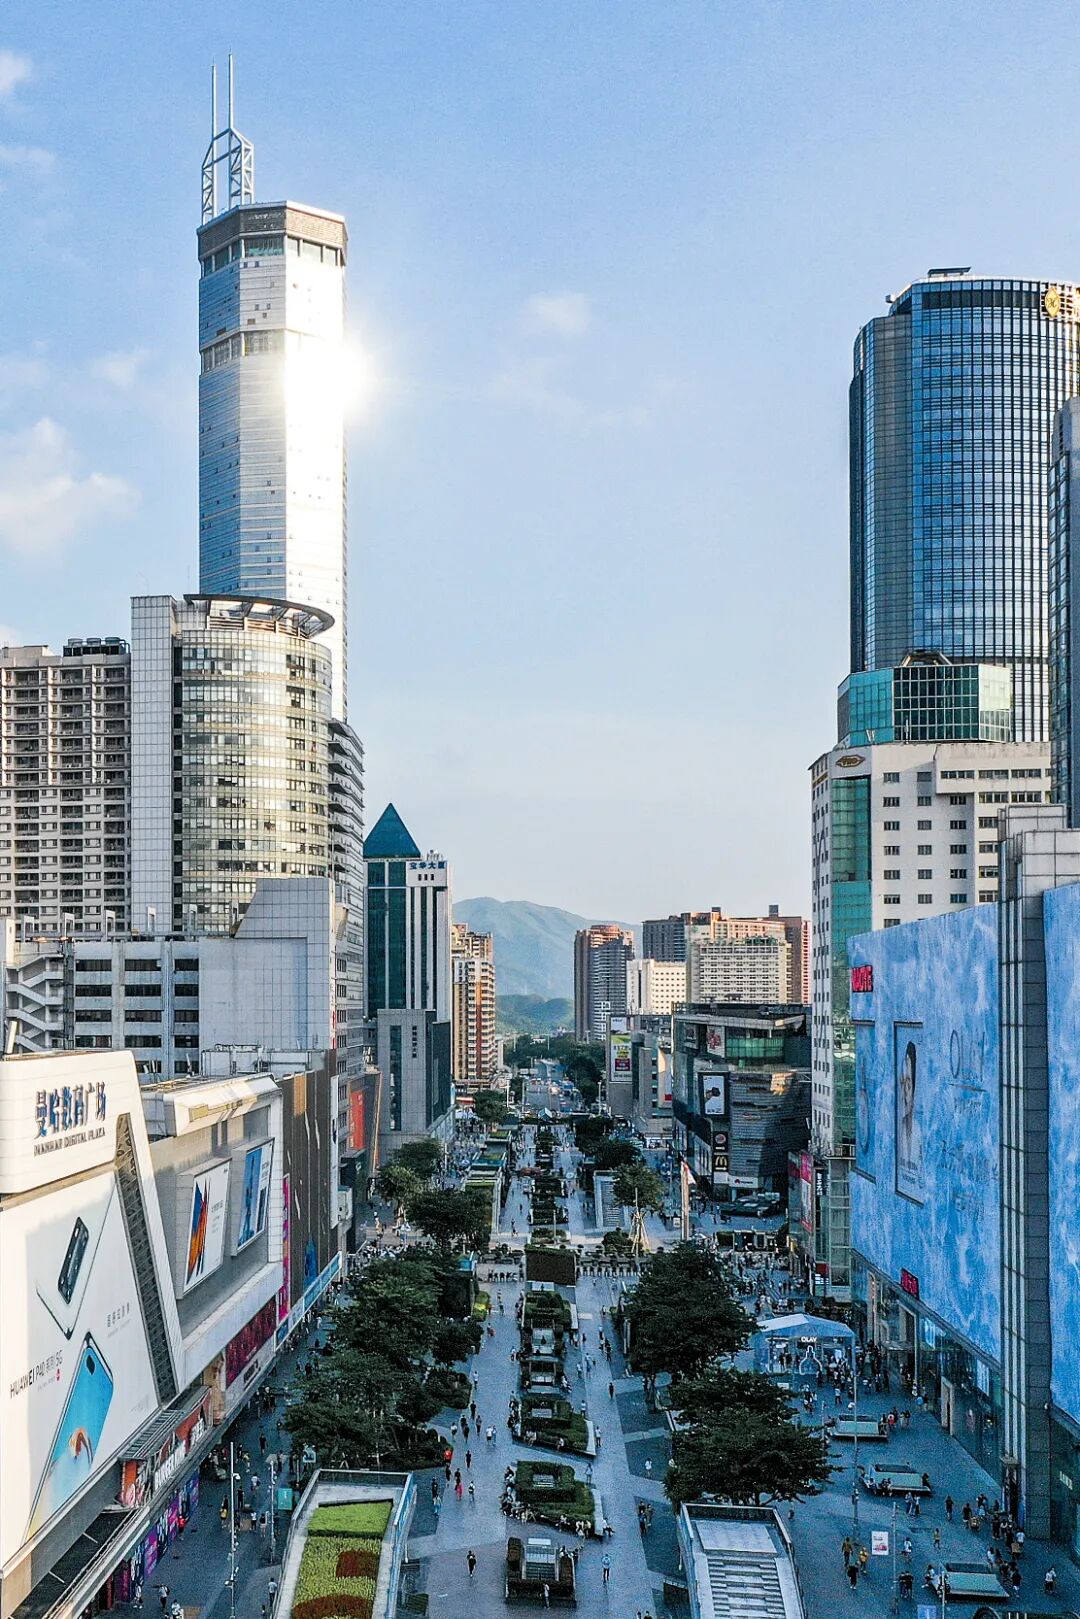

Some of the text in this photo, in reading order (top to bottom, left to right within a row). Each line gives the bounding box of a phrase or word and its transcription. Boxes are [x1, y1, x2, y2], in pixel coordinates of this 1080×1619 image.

[34, 1081, 106, 1139] 曼哈数码广场
[63, 1132, 87, 1149] DIGITAL
[88, 1127, 106, 1141] PLAZA
[10, 1368, 35, 1399] HUAWEI
